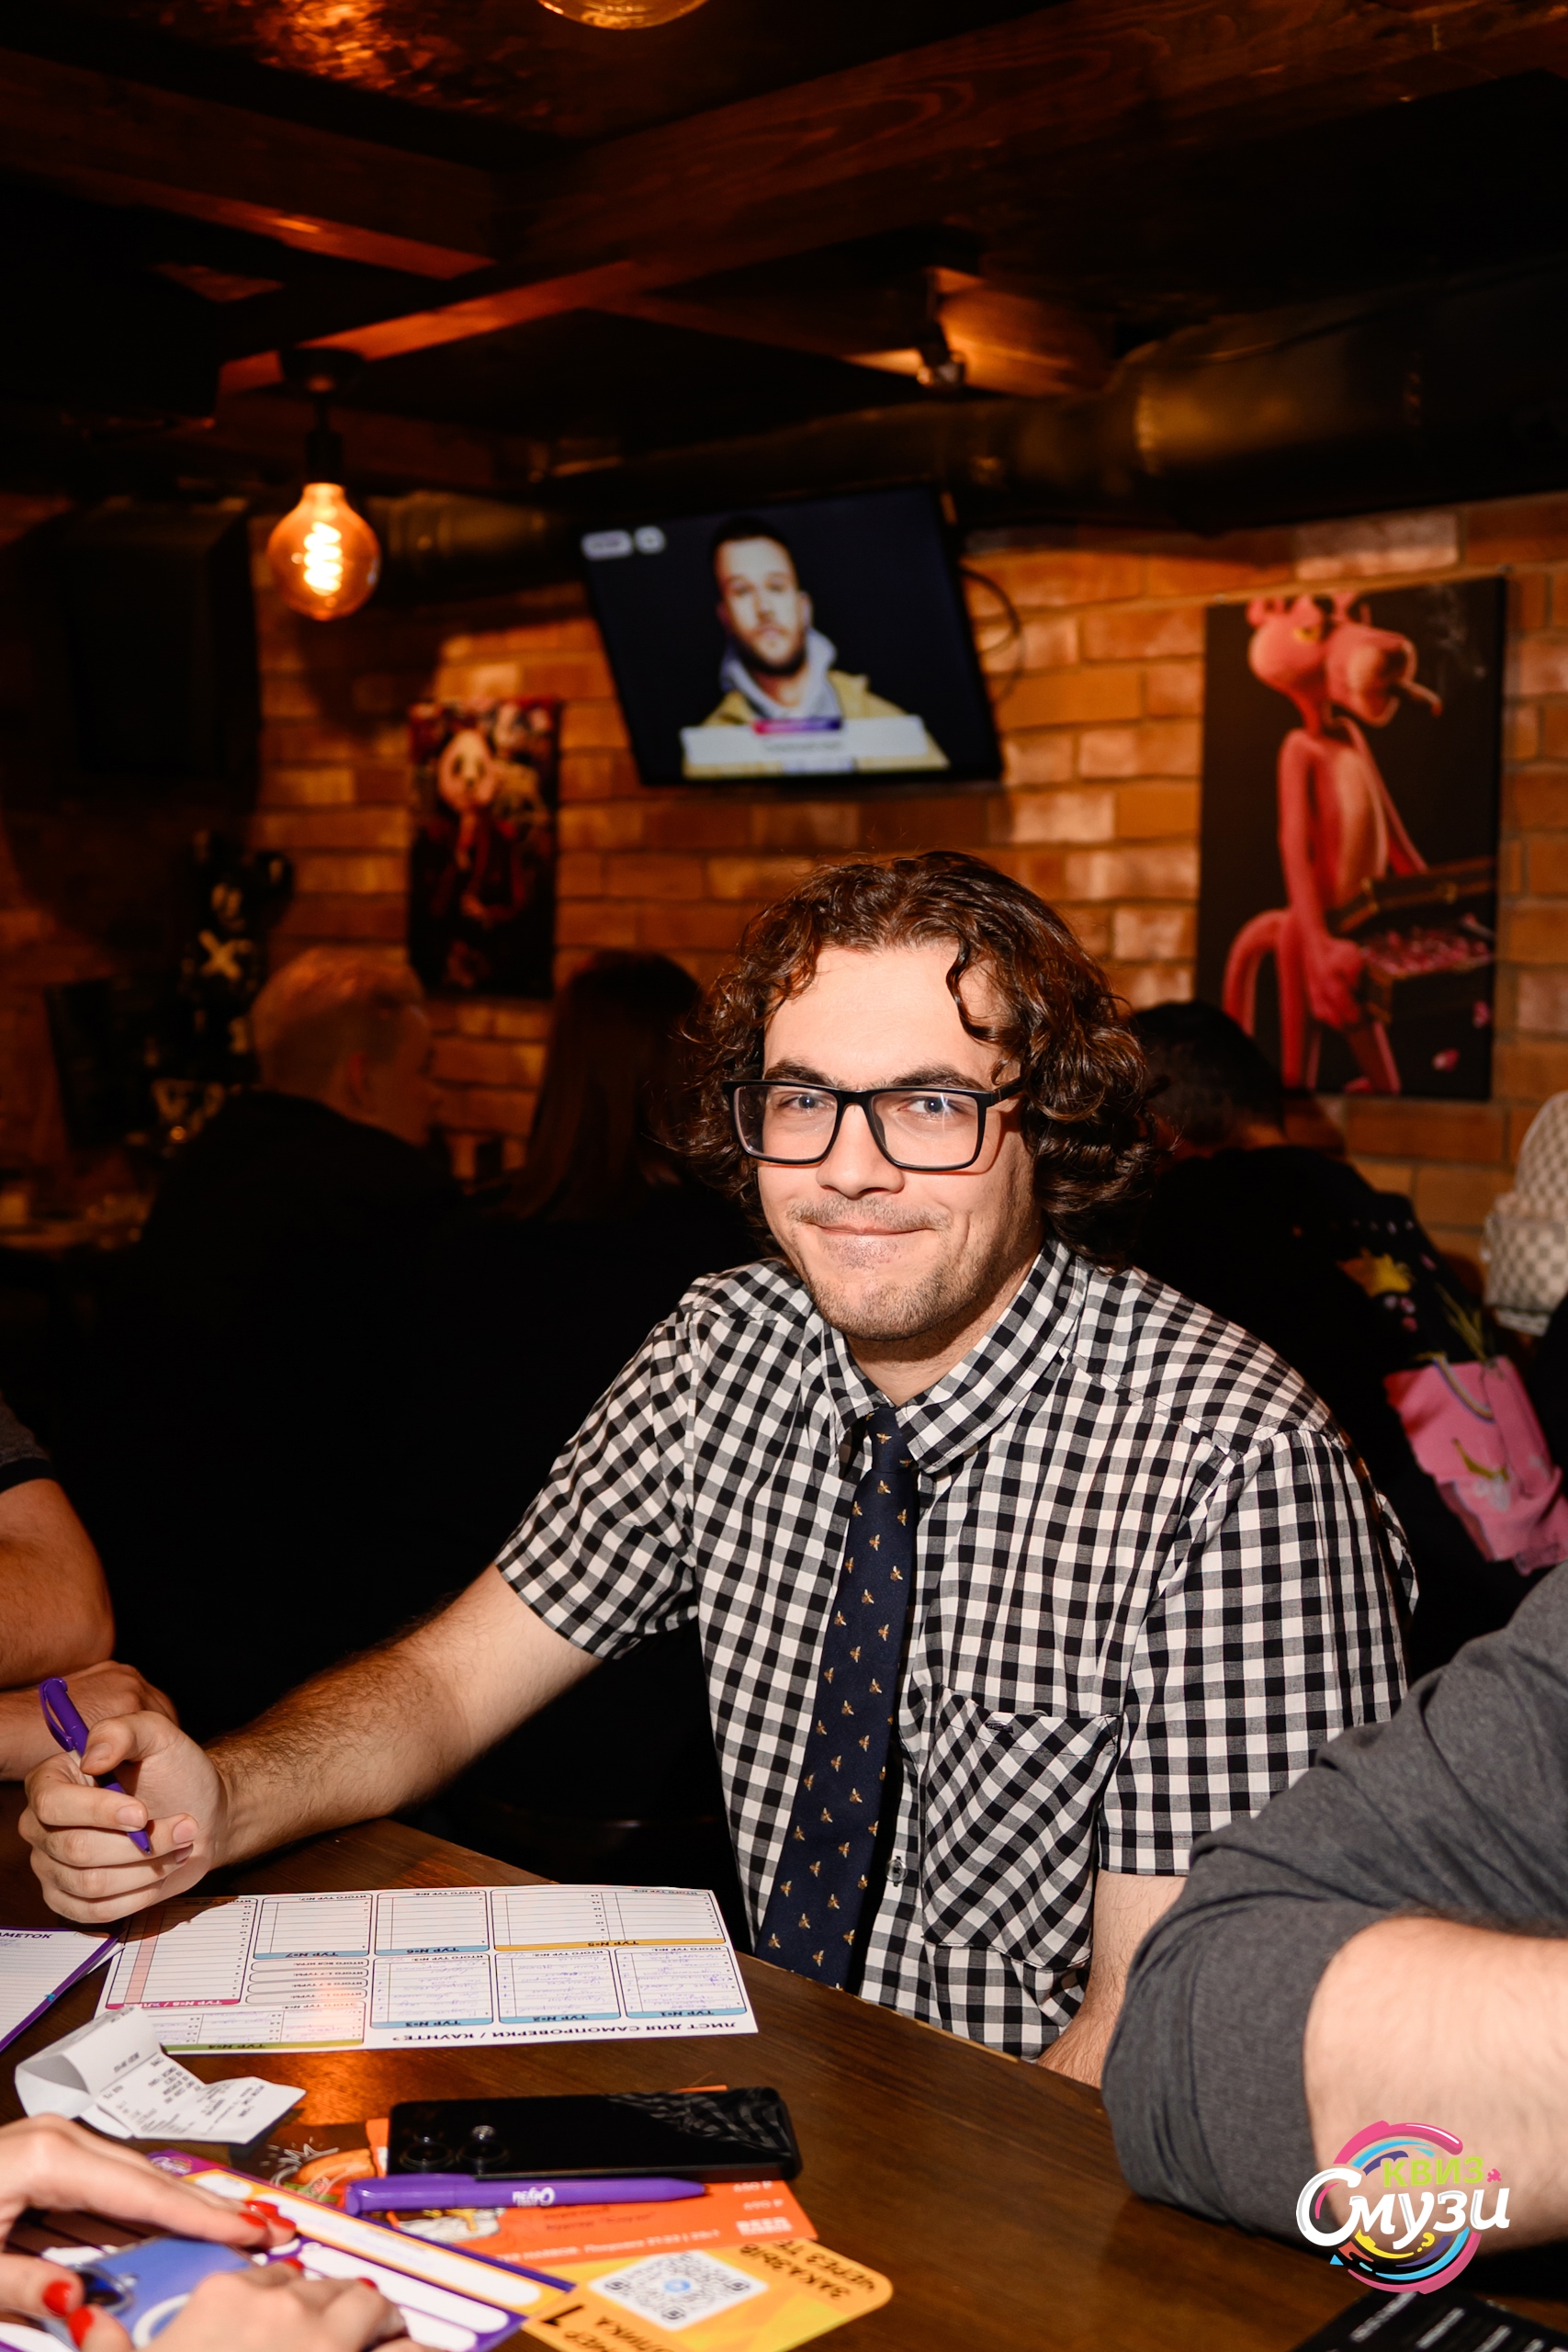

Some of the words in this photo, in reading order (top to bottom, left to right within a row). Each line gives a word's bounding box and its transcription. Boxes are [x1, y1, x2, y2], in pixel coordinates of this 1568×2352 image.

[492, 2025, 640, 2038] САМОПРОВЕРКИ
[646, 2023, 682, 2031] ДЛЯ
[805, 2254, 875, 2294] ЧЕРЕЗ
[538, 2304, 586, 2328] 1
